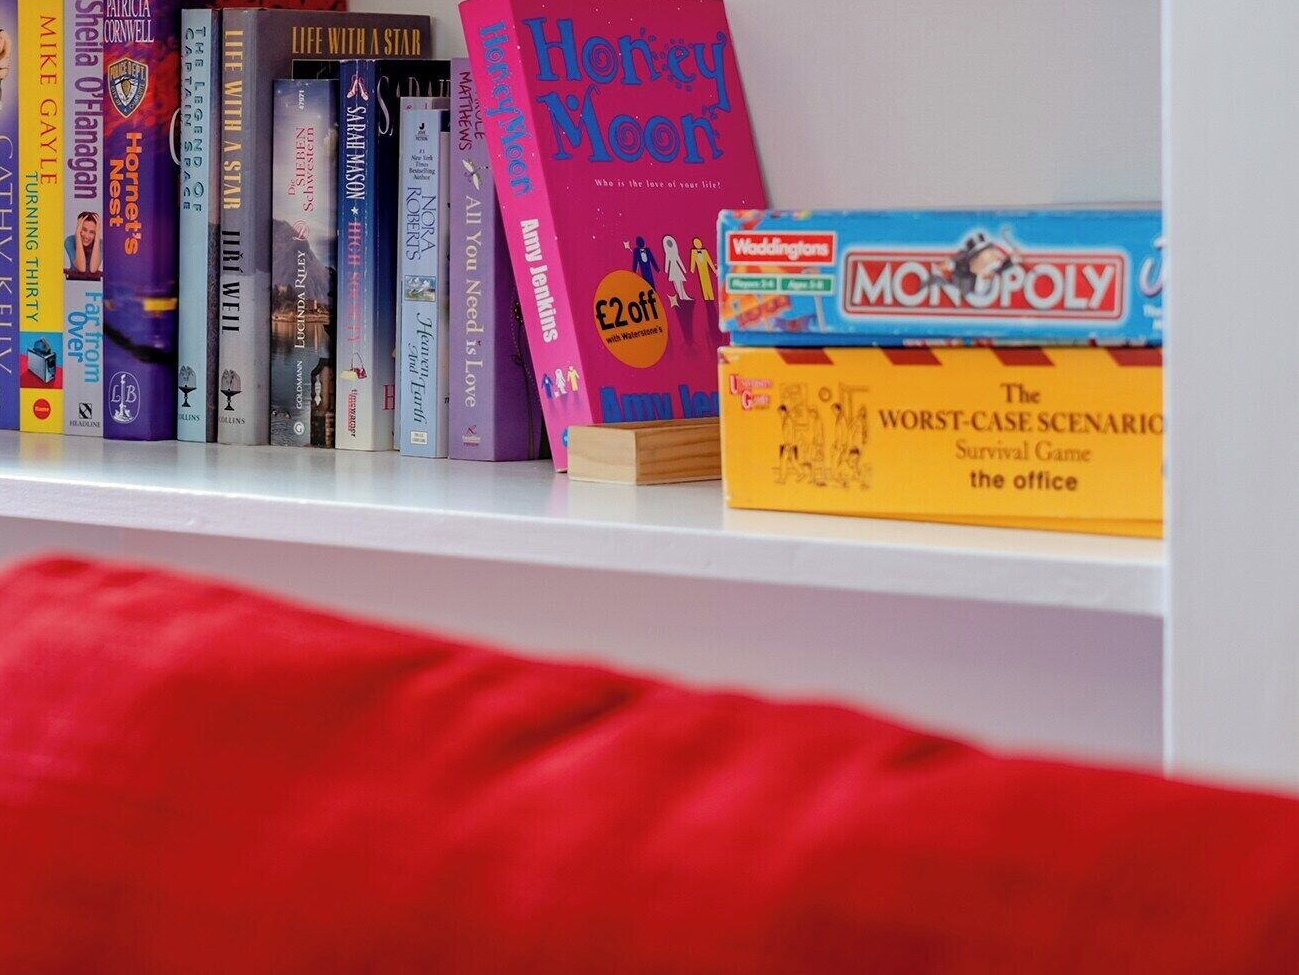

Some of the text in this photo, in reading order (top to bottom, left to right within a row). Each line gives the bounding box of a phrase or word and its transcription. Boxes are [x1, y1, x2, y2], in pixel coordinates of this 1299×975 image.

[104, 19, 154, 43] CORNWELL
[293, 27, 421, 56] LIFE WITH A STAR
[521, 16, 731, 114] Honey
[40, 15, 57, 185] MIKE GAYLE
[67, 0, 104, 199] Sheila O'Flanagan
[183, 27, 195, 209] CAPTAIN SPACE
[193, 26, 206, 212] THE LEGEND OF
[223, 30, 243, 210] LIFE WITH A STAR
[458, 72, 473, 151] MATTHEWS
[536, 84, 723, 164] Moon
[296, 128, 305, 186] SIEBEN
[303, 127, 314, 212] Schwestern
[346, 106, 366, 200] SARAH MASON
[595, 179, 614, 187] Who
[617, 179, 625, 187] is
[629, 179, 642, 188] the
[646, 180, 663, 188] love
[668, 180, 676, 188] of
[109, 159, 123, 227] Nest
[125, 133, 142, 256] Hornet's
[405, 187, 421, 261] ROBERTS
[421, 195, 436, 252] NORA
[25, 171, 39, 322] TURNING THIRTY
[348, 222, 361, 265] HIGH
[733, 237, 829, 261] Waddingtons
[222, 281, 240, 334] WEIL
[294, 250, 306, 348] LUCINDA RILEY
[465, 196, 484, 407] All You Need is Love
[520, 219, 558, 344] Amy Jenkins
[596, 289, 658, 330] £2 off
[67, 311, 88, 363] Over
[84, 292, 103, 384] Far from
[416, 312, 434, 378] Heaven
[606, 325, 663, 344] with Waterstone's
[70, 420, 100, 428] HEADLINE
[410, 377, 427, 424] Earth
[878, 410, 1032, 432] WORST-CASE
[1001, 383, 1040, 404] The
[955, 439, 1091, 462] Survival Game
[971, 470, 1078, 491] the office
